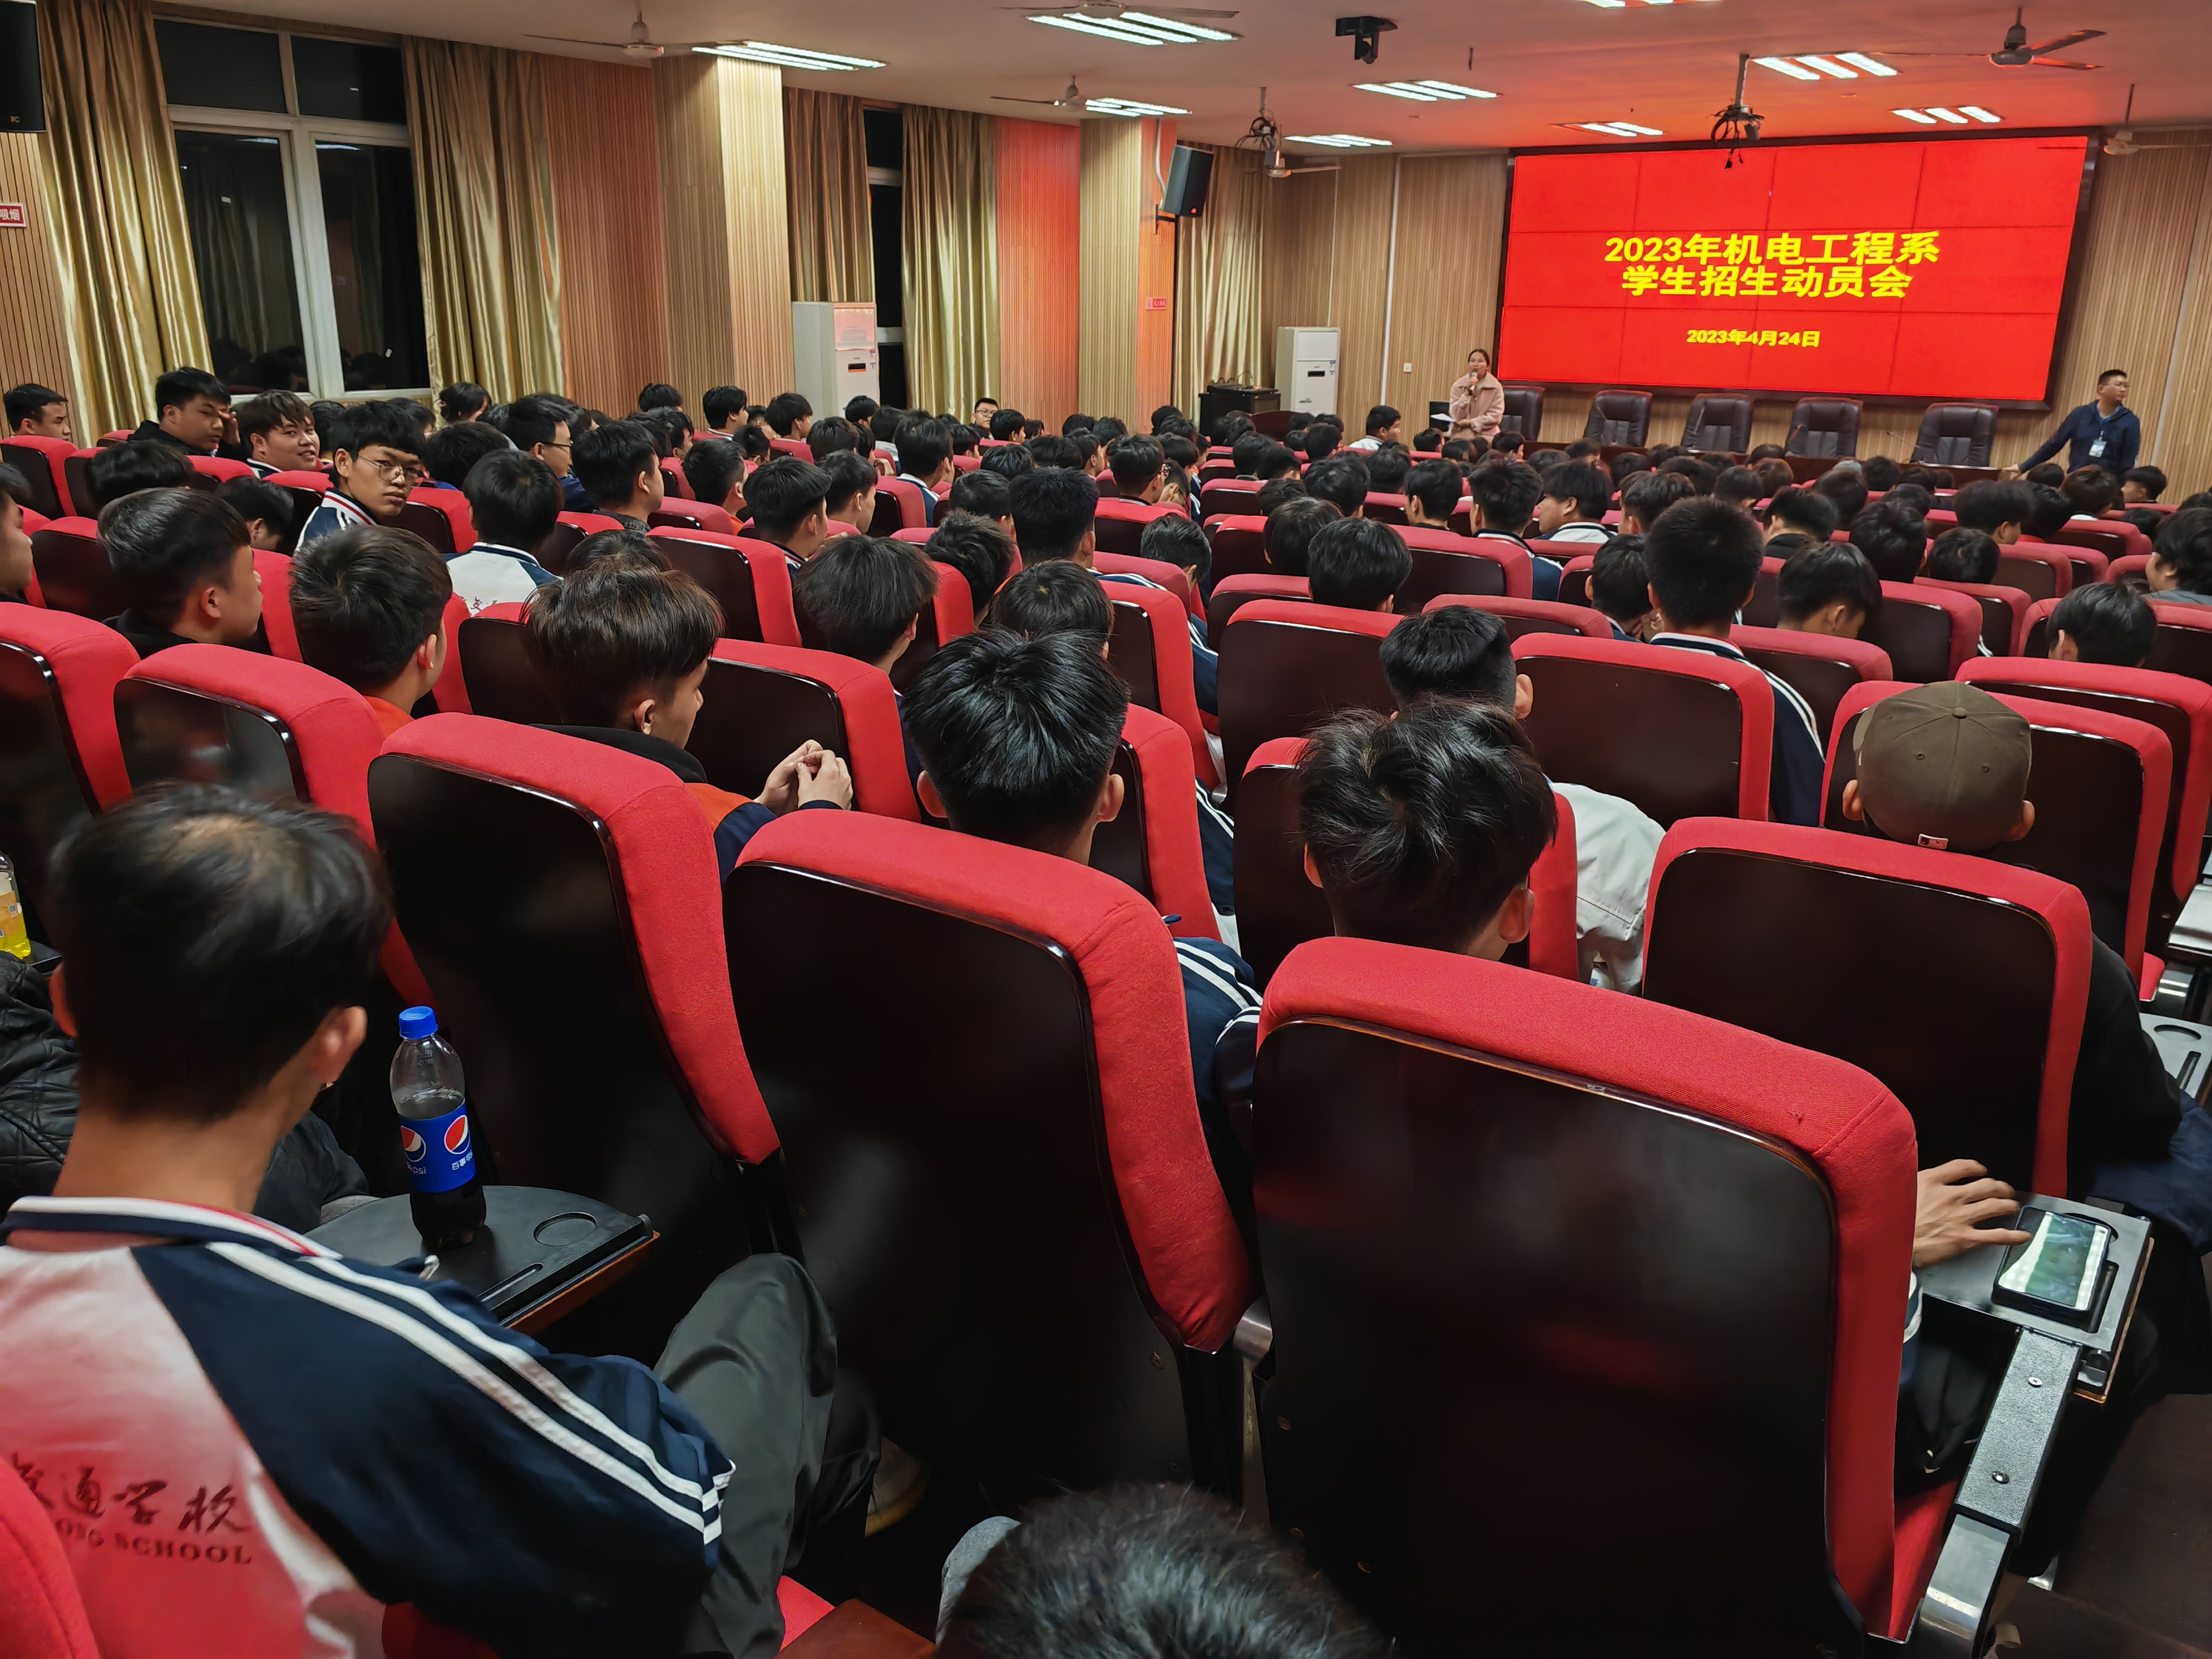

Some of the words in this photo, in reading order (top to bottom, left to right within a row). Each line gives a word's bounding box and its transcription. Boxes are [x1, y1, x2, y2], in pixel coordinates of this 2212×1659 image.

[1604, 231, 1940, 265] 2023年机电工程系
[1621, 265, 1913, 298] 学生招生动员会
[1686, 329, 1820, 347] 2023年4月24日
[114, 1533, 252, 1564] SCHOOL
